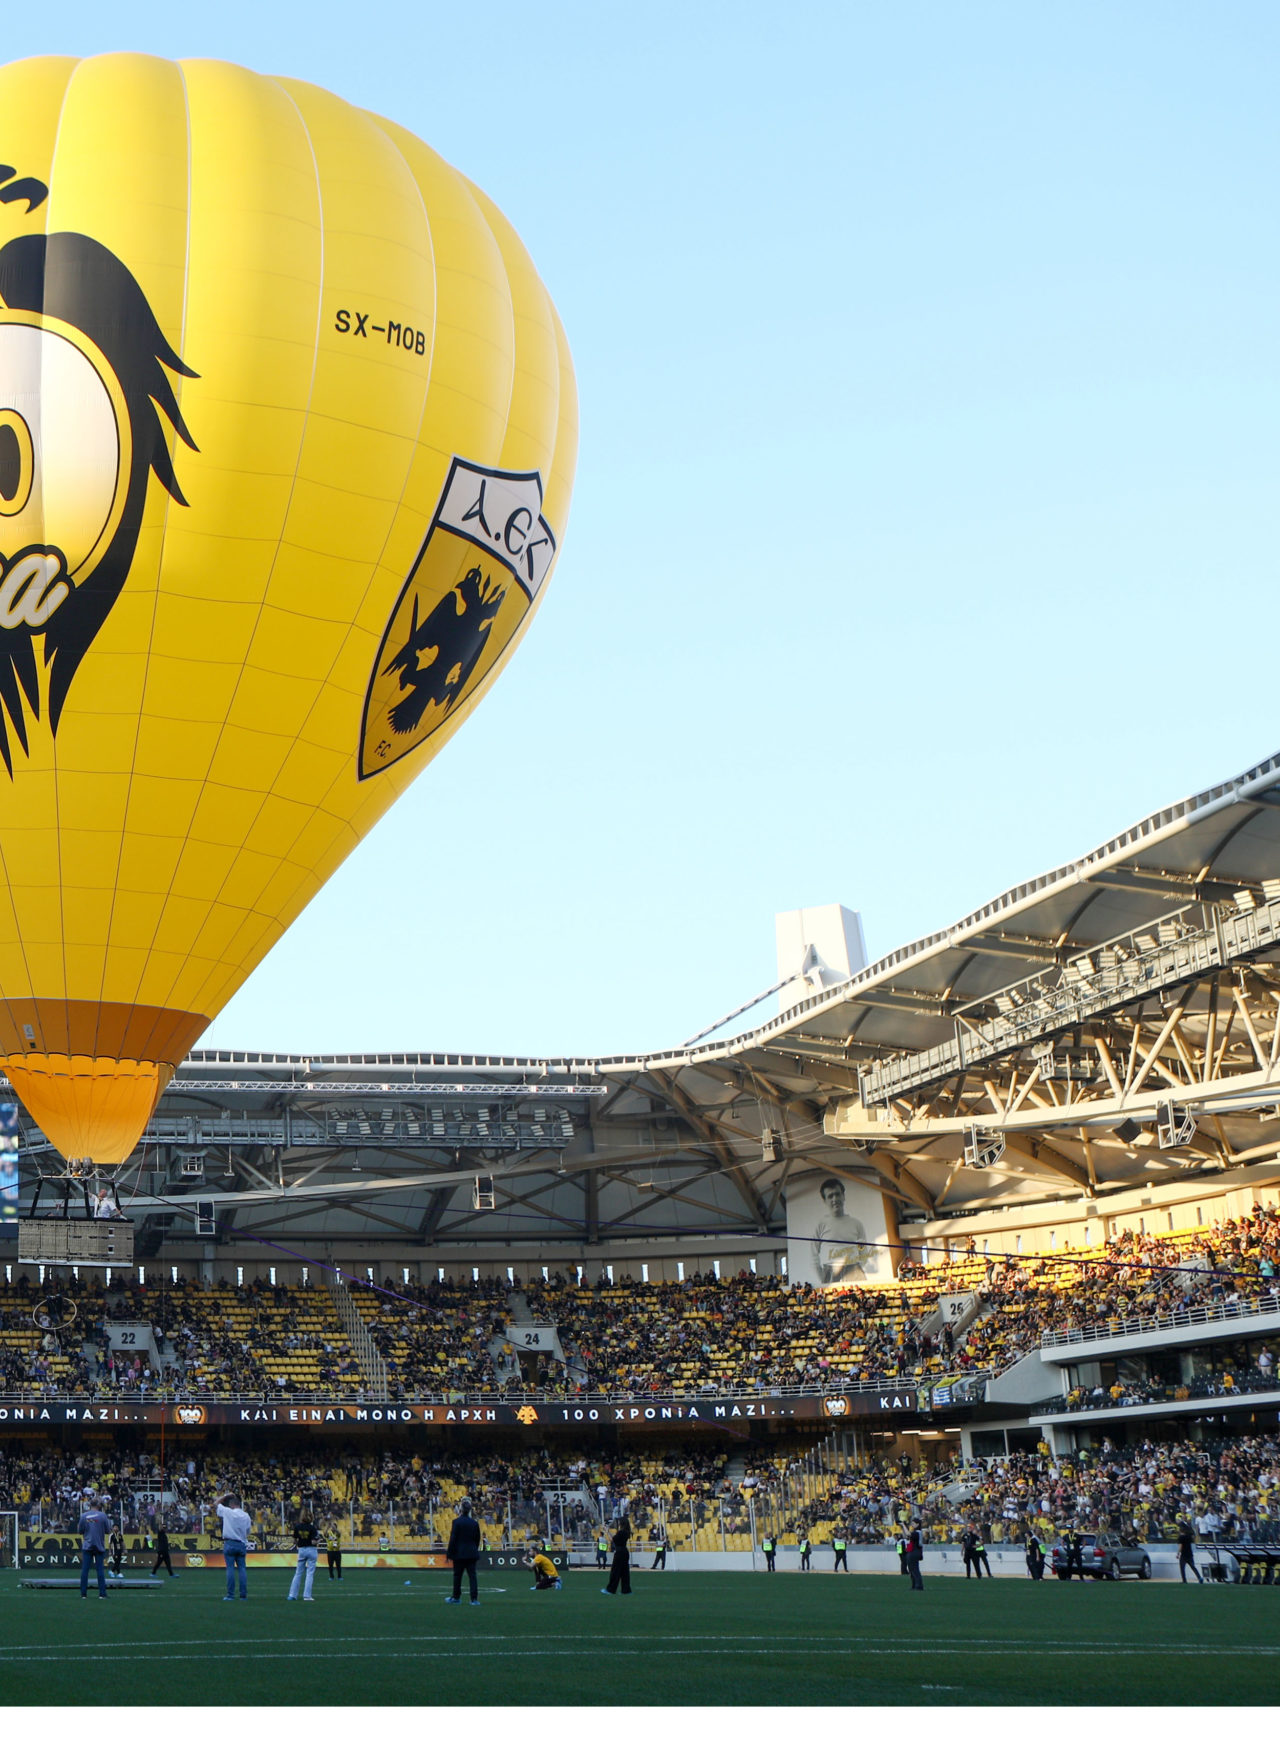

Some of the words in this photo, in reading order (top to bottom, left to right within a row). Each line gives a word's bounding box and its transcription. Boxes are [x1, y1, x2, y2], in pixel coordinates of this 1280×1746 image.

[334, 308, 426, 357] SX-MOB
[373, 739, 392, 759] F.C.
[120, 1332, 136, 1345] 22
[524, 1333, 540, 1345] 24
[880, 1395, 911, 1409] ΚΑΙ
[240, 1409, 277, 1421] ΚΑΙ
[289, 1409, 344, 1421] ΕΙΝΑΙ
[356, 1409, 412, 1421] ΜΟΝΟ
[424, 1409, 434, 1421] Η
[446, 1409, 496, 1421] ΑΡΧΗ
[562, 1409, 599, 1420] 100
[614, 1407, 699, 1420] ΧΡΟΝΙΑ
[553, 1493, 567, 1504] 25
[488, 1557, 518, 1565] 100
